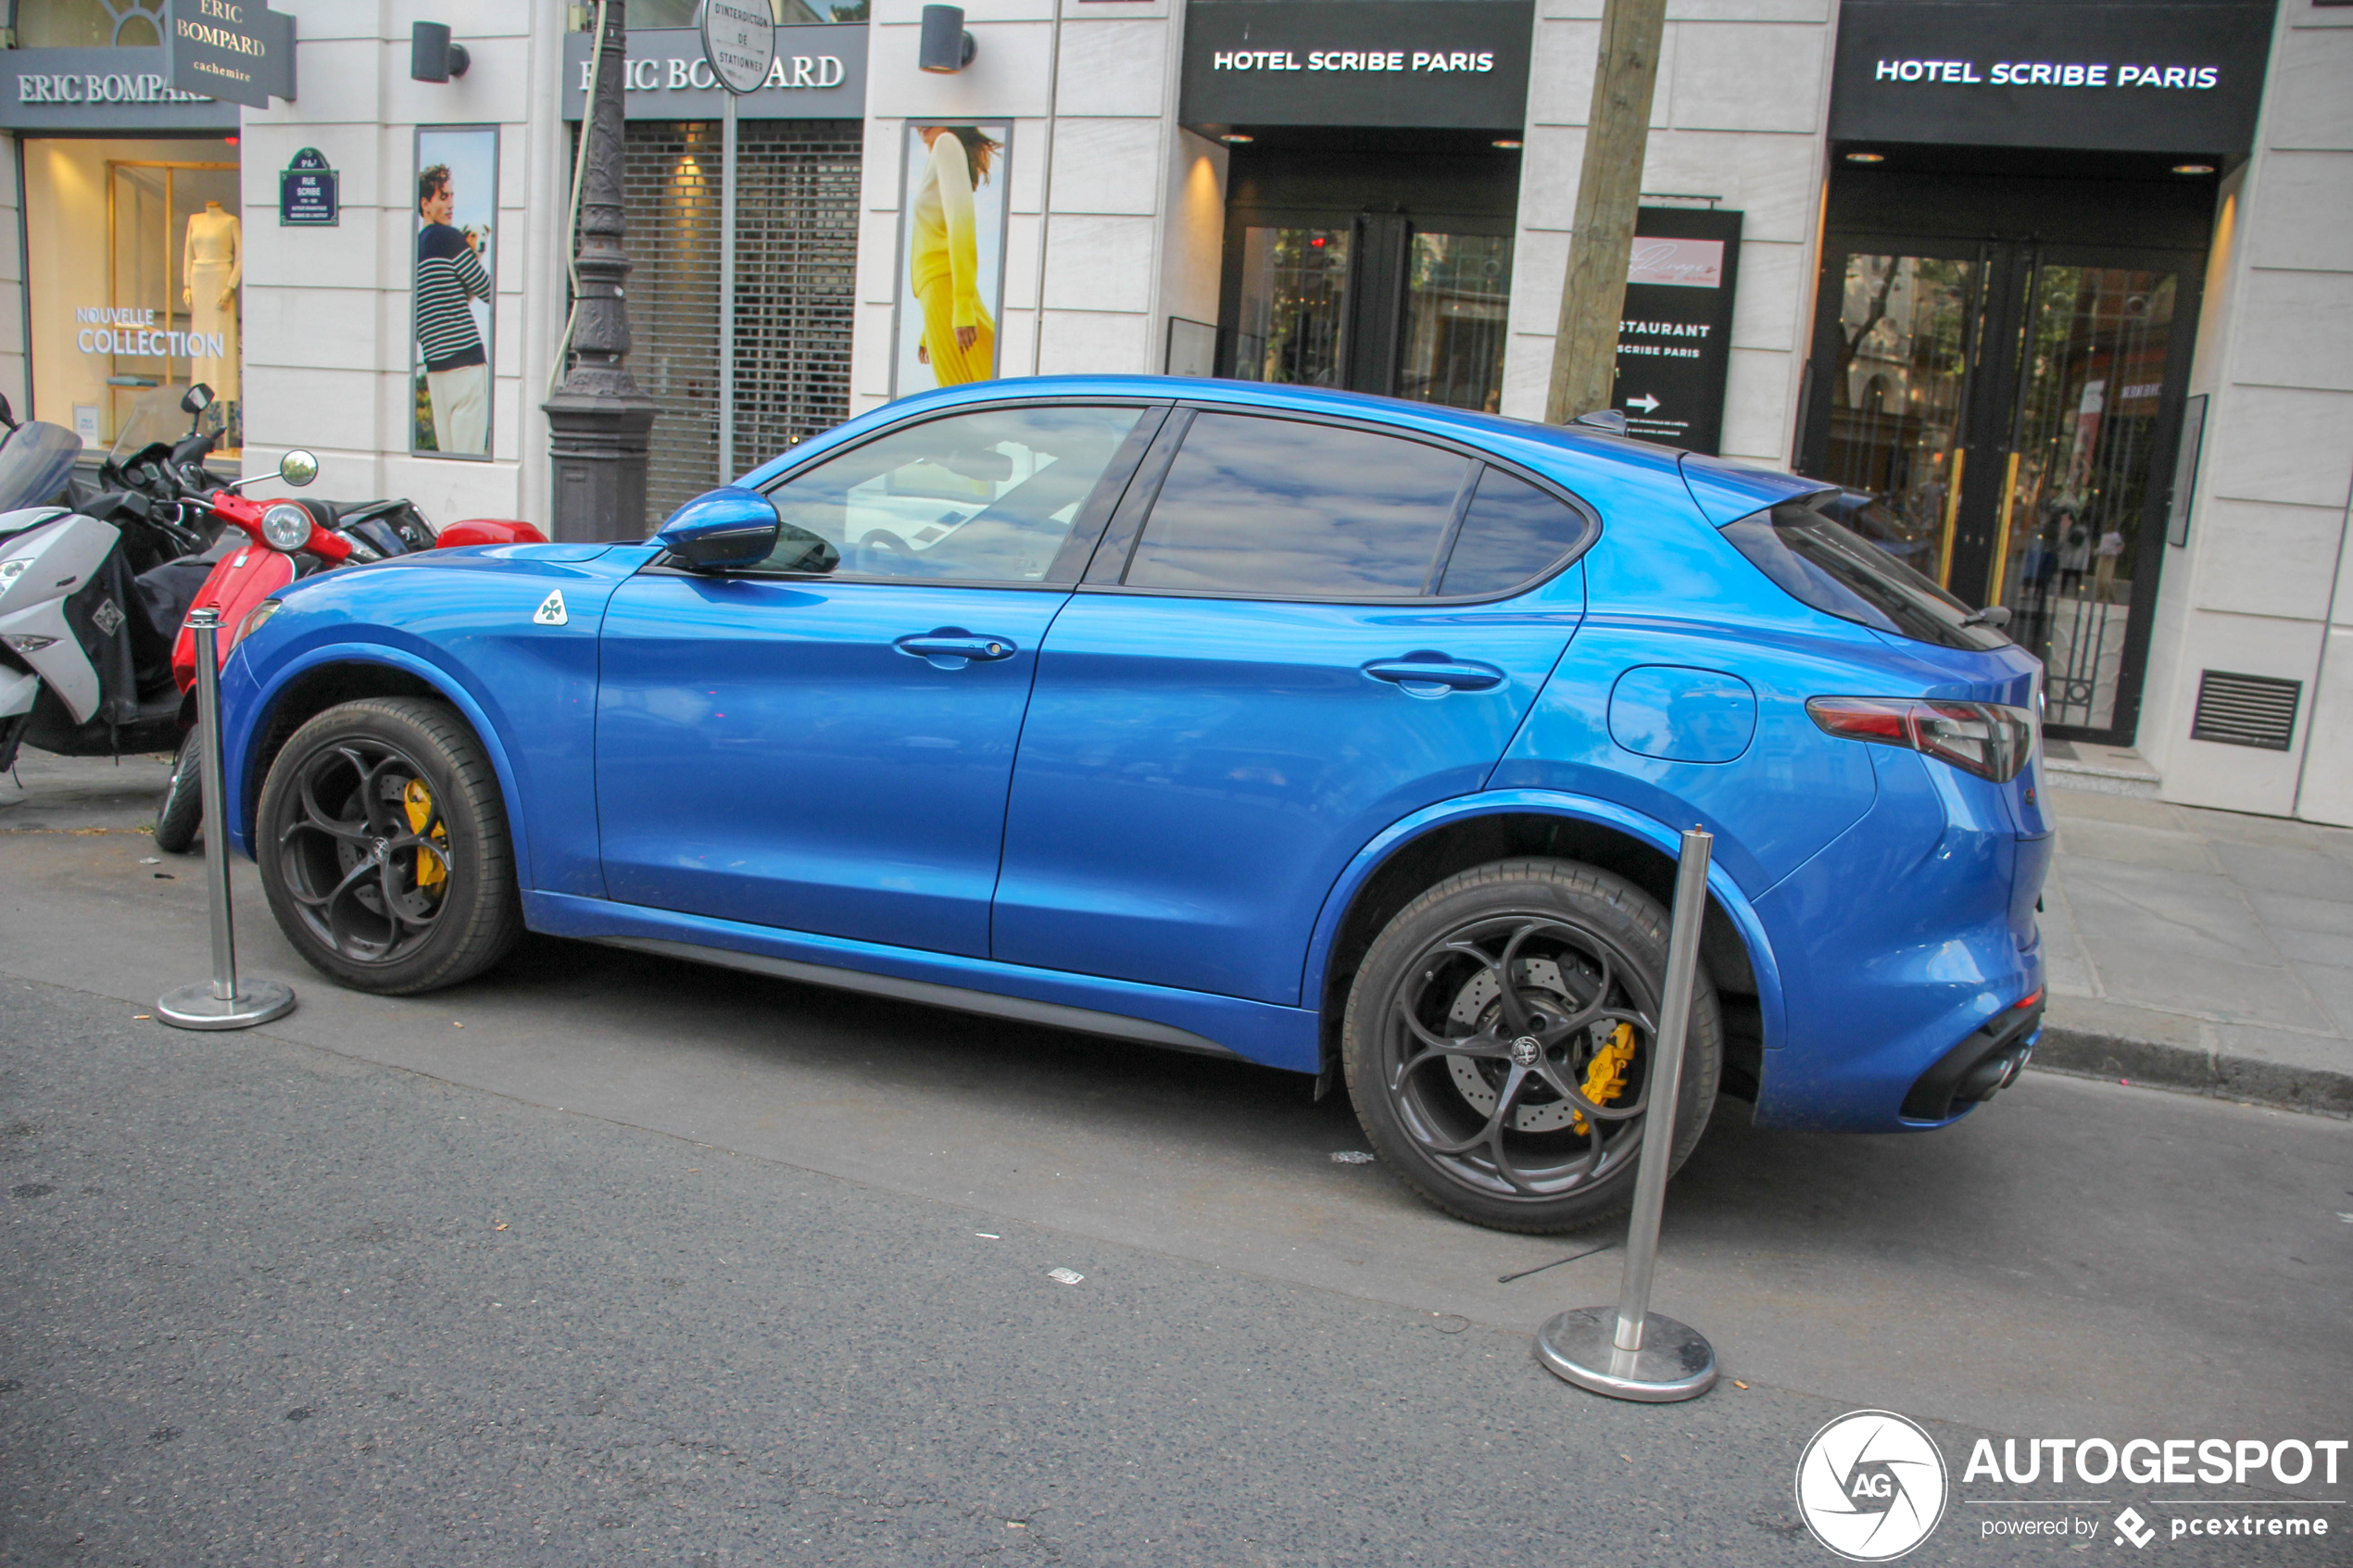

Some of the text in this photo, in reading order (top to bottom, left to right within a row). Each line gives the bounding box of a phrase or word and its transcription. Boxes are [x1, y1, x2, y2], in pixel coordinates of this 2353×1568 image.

[201, 0, 244, 23] ERIC
[715, 3, 768, 28] D'INTERDICTION
[176, 19, 266, 57] BOMPARD
[737, 33, 748, 45] DE
[194, 59, 251, 82] cachemire
[719, 51, 763, 72] STATIONNER
[1214, 51, 1494, 73] HOTEL SCRIBE PARIS
[579, 56, 846, 90] EIC BOARD
[1875, 59, 2219, 89] HOTEL SCRIBE PARIS
[18, 74, 82, 103] ERIC
[296, 187, 321, 196] SCRIBE
[301, 177, 317, 185] RUE
[76, 307, 155, 325] NOUVELLE
[1618, 320, 1711, 338] STAURANT
[77, 328, 224, 358] COLLECTION
[1617, 344, 1701, 358] SCRIBE PARIS
